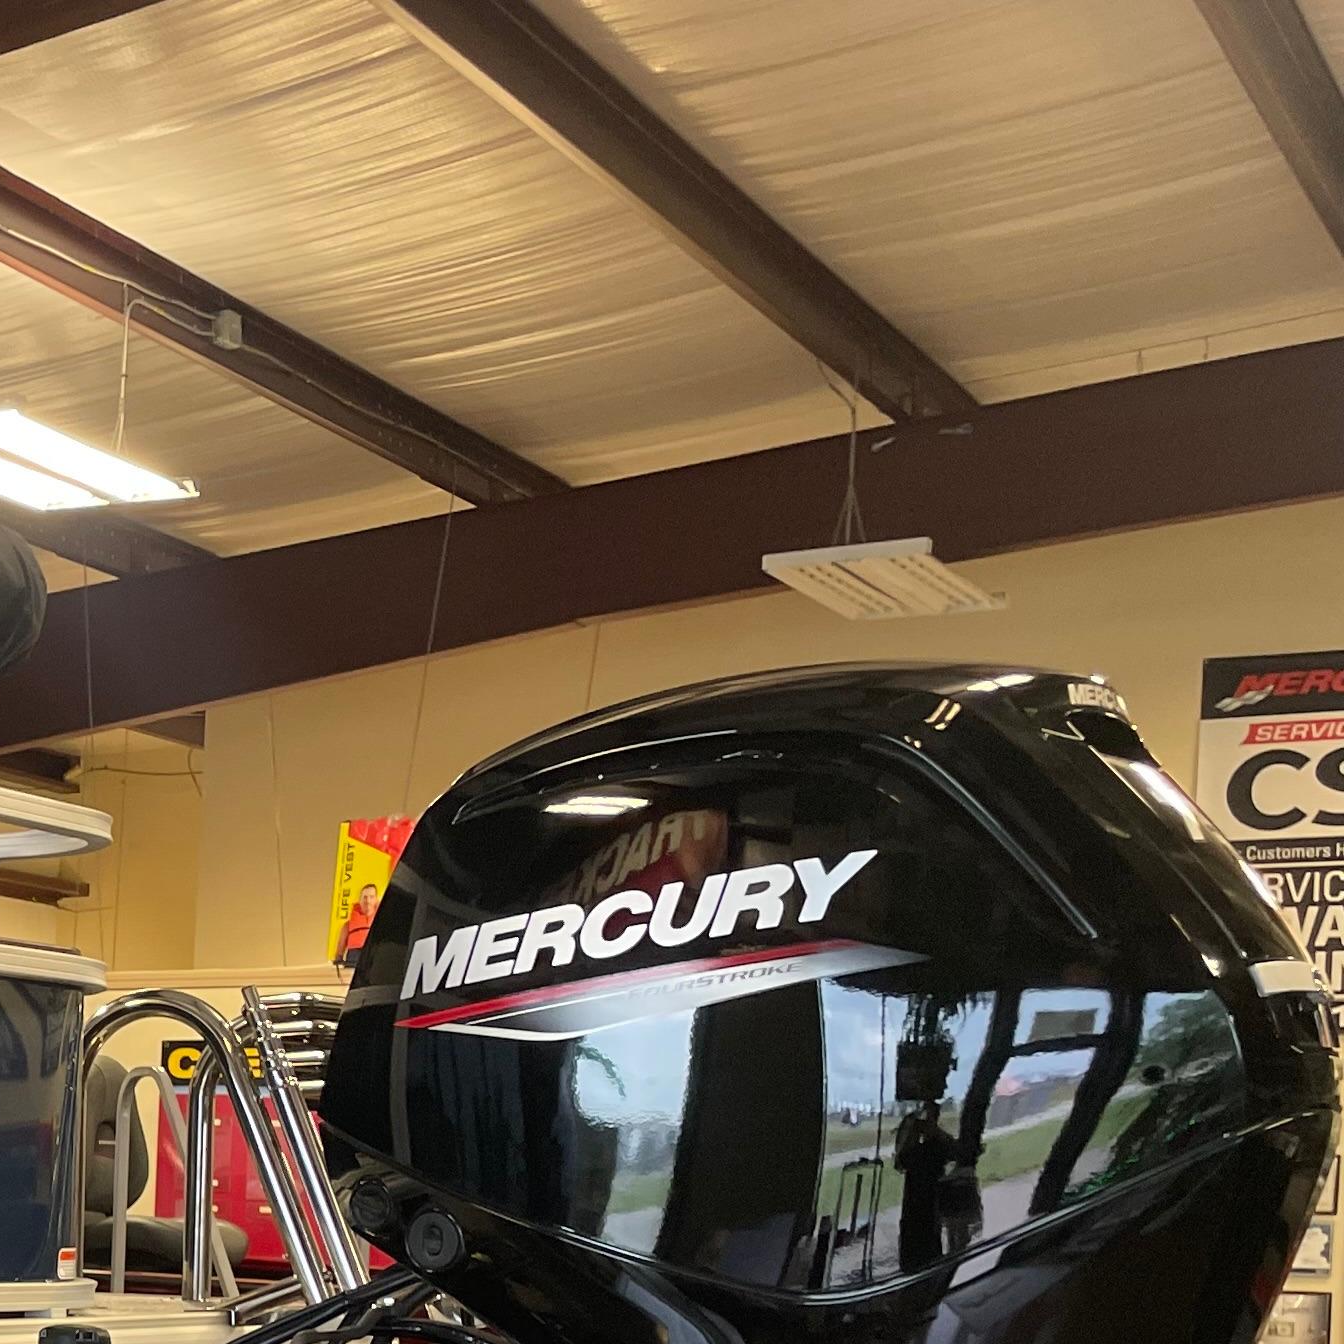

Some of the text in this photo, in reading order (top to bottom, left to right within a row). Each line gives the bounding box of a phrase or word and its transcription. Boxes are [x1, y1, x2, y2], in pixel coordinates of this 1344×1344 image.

[343, 842, 356, 882] VEST
[1246, 846, 1331, 861] Customers
[339, 887, 352, 920] LIFE
[399, 848, 879, 1001] MERCURY
